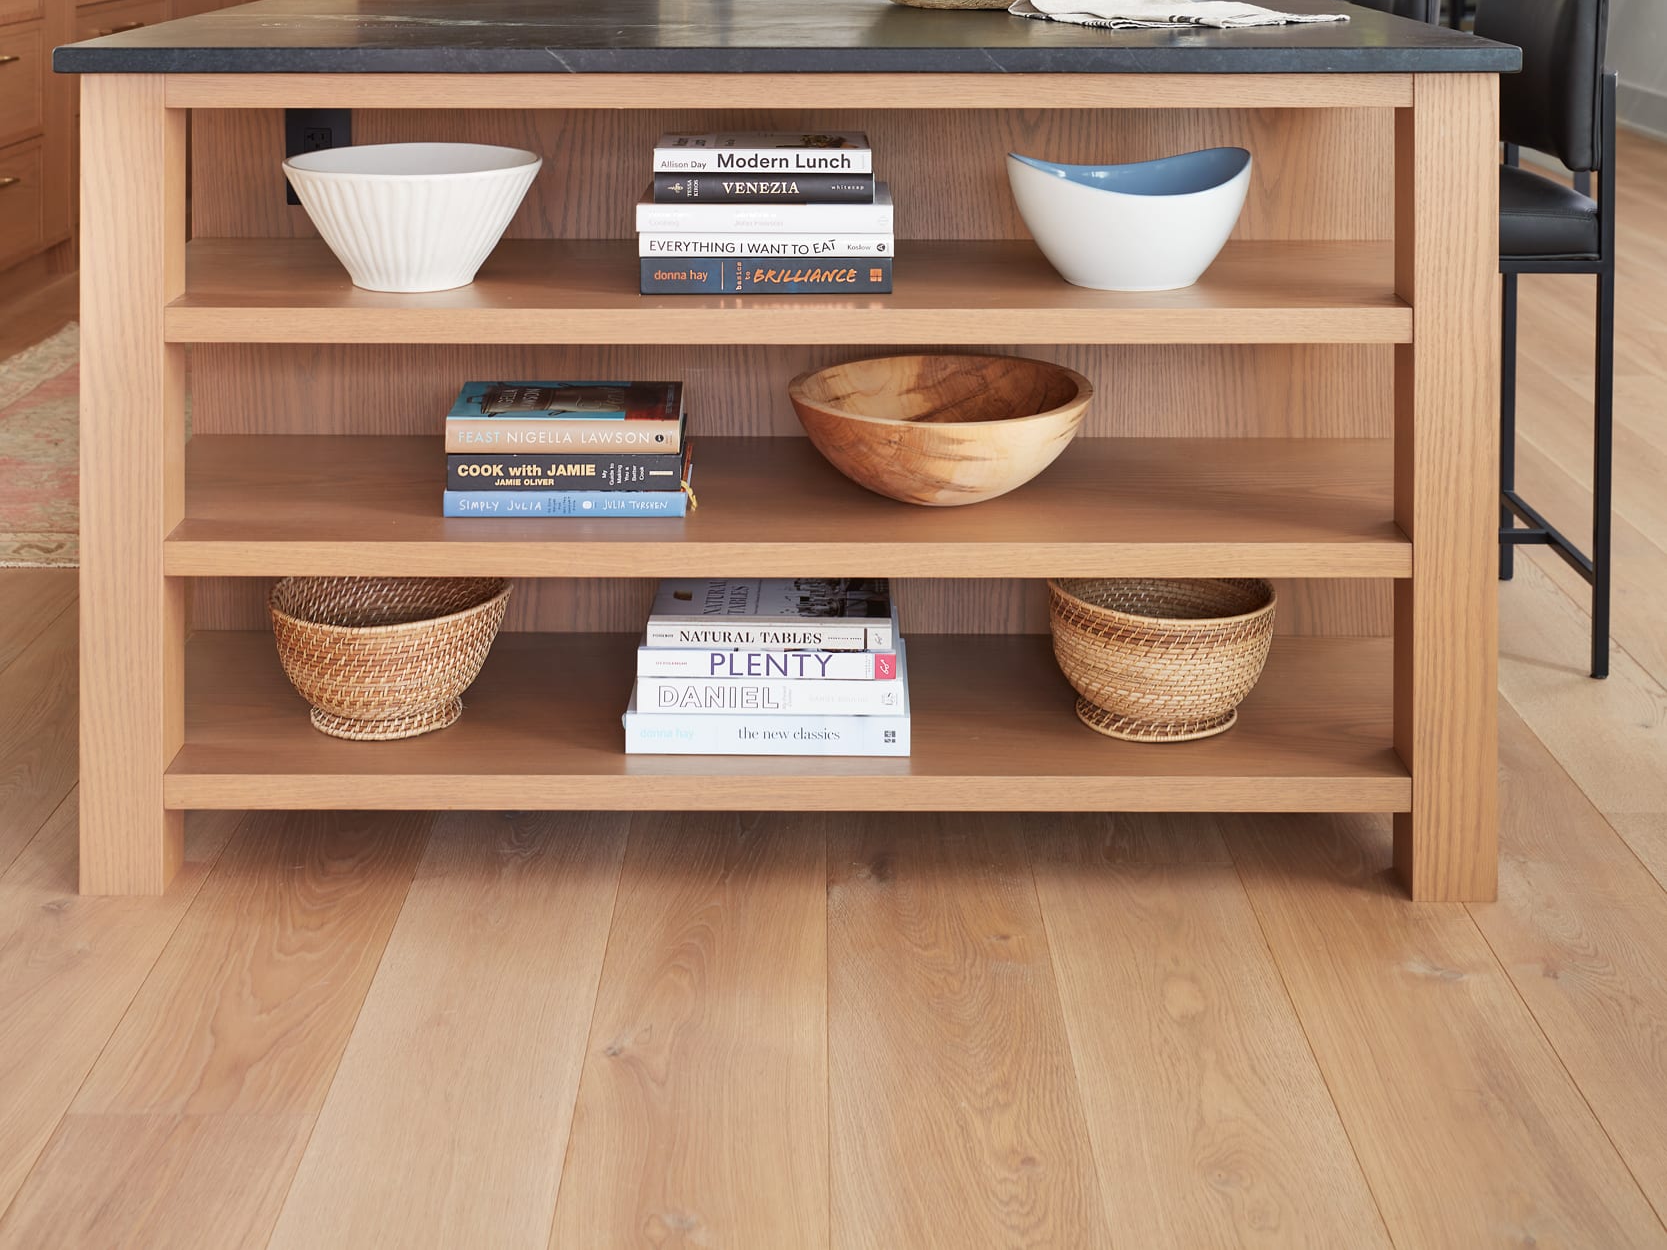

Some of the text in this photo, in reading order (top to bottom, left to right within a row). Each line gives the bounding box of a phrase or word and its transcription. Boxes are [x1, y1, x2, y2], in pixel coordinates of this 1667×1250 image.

[660, 160, 707, 170] Allison Day
[717, 154, 851, 169] Modern Lunch
[722, 182, 800, 194] VENEZIA
[650, 239, 836, 255] EVERYTHING I WANT TO EAT
[654, 269, 708, 283] donna hay
[753, 268, 857, 284] BRILLIANCE
[458, 432, 650, 444] FEAST NIGELLA LAWSON
[457, 464, 596, 477] COOK with JAMIE
[601, 470, 607, 479] My
[495, 478, 555, 486] JAMIE OLIVER
[459, 500, 499, 512] SIMPLY
[507, 501, 542, 511] JULIA
[602, 500, 626, 510] JULIA
[703, 579, 729, 615] NATURAL
[727, 585, 750, 615] TABLES
[679, 630, 823, 645] NATURAL TABLES
[710, 652, 833, 678] PLENTY
[658, 685, 780, 709] DANIEL
[640, 728, 695, 742] donna hay
[738, 726, 841, 741] the new classics
